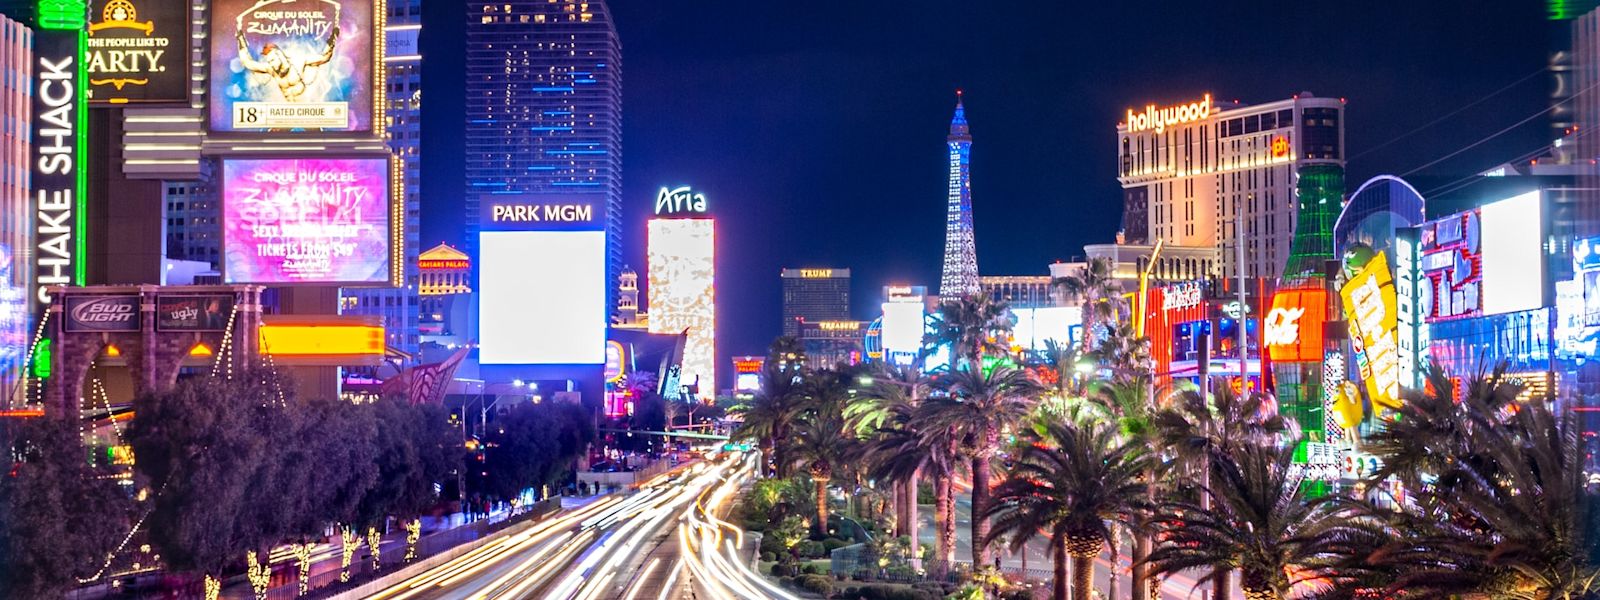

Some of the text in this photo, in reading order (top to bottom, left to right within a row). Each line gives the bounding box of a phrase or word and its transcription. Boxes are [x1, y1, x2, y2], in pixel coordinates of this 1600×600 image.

[253, 11, 283, 20] CIRQUE
[298, 11, 326, 19] SOLEIL
[246, 18, 332, 41] ZUMANITY
[88, 37, 169, 47] THE PEOPLE LIKE TO
[38, 55, 73, 176] SHACK
[269, 108, 326, 117] RATED CIRQUE
[1127, 93, 1210, 135] hollywood
[254, 171, 357, 185] CIRQUE DU SOLEIL
[655, 186, 707, 215] Aria
[493, 205, 592, 222] PARK MGM
[256, 243, 300, 257] TICKETS
[800, 269, 832, 278] TRUMP
[89, 303, 133, 313] BUD
[171, 306, 198, 321] ugly
[79, 312, 135, 322] LIGHT
